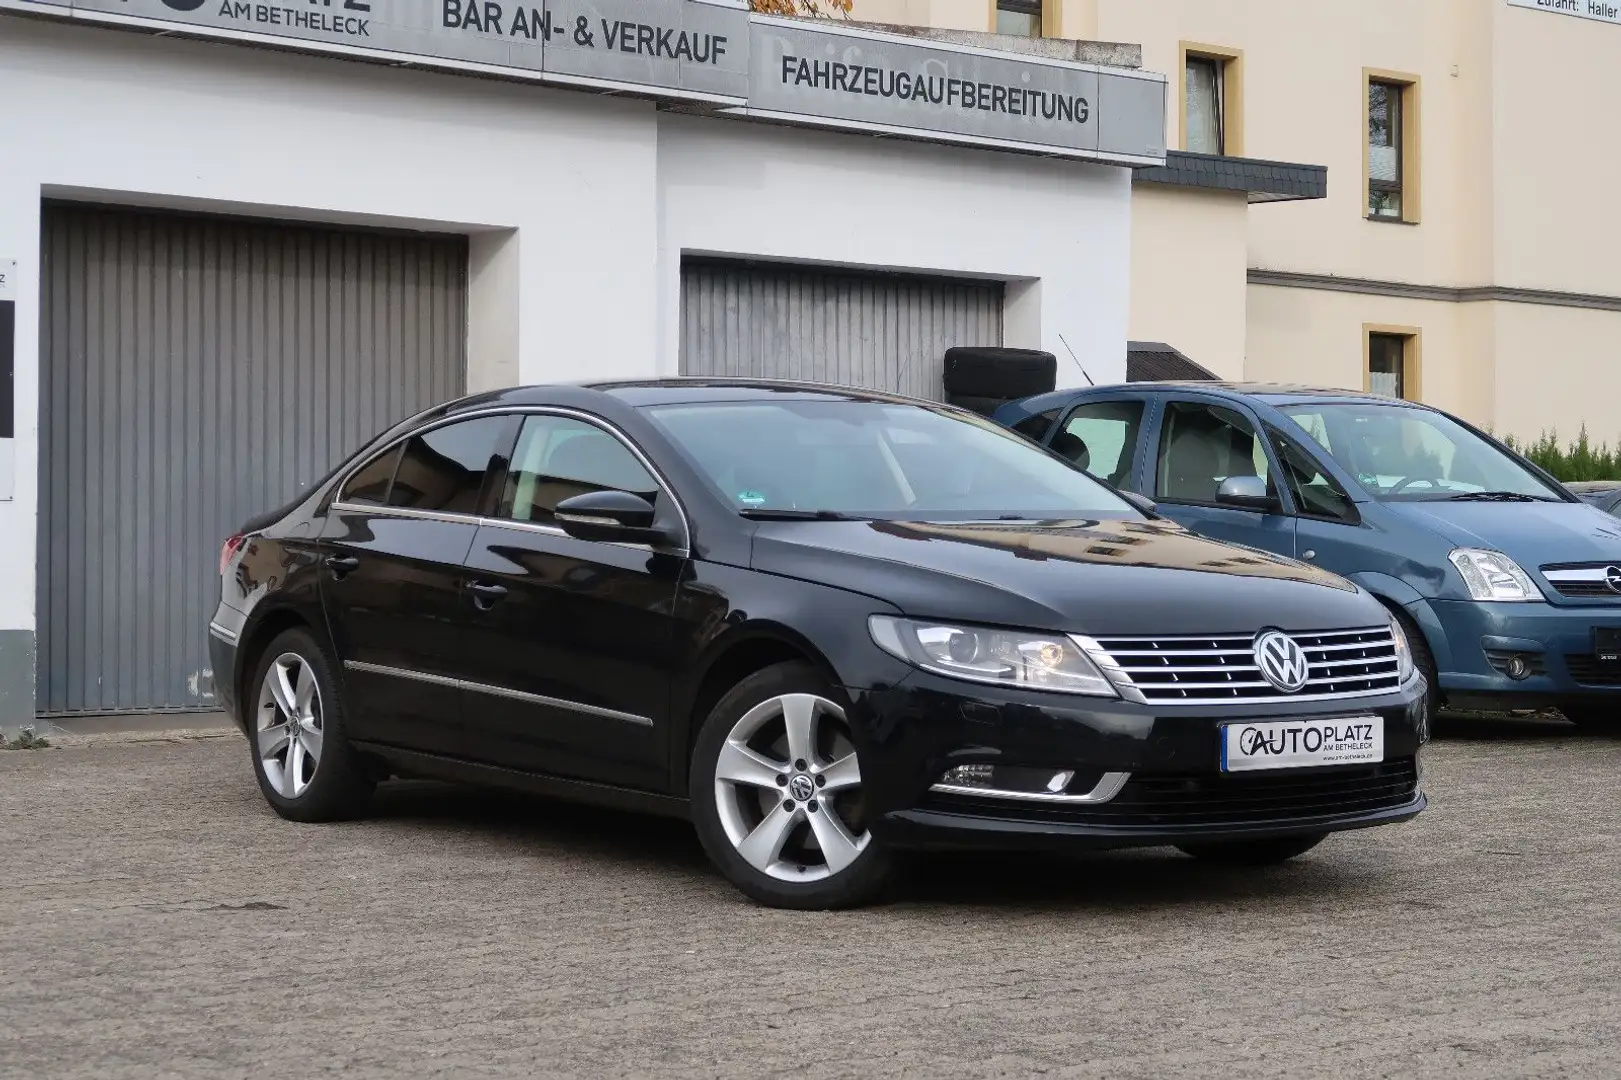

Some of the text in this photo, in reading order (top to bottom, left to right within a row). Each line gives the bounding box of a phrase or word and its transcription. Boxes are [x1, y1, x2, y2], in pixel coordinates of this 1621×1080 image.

[218, 1, 251, 21] AM
[256, 5, 370, 37] BETHELECK
[443, 0, 728, 65] BAR AN- & VERKAUF
[1588, 0, 1618, 18] Haller
[781, 55, 1089, 124] FAHRZEUGAUFBEREITUNG
